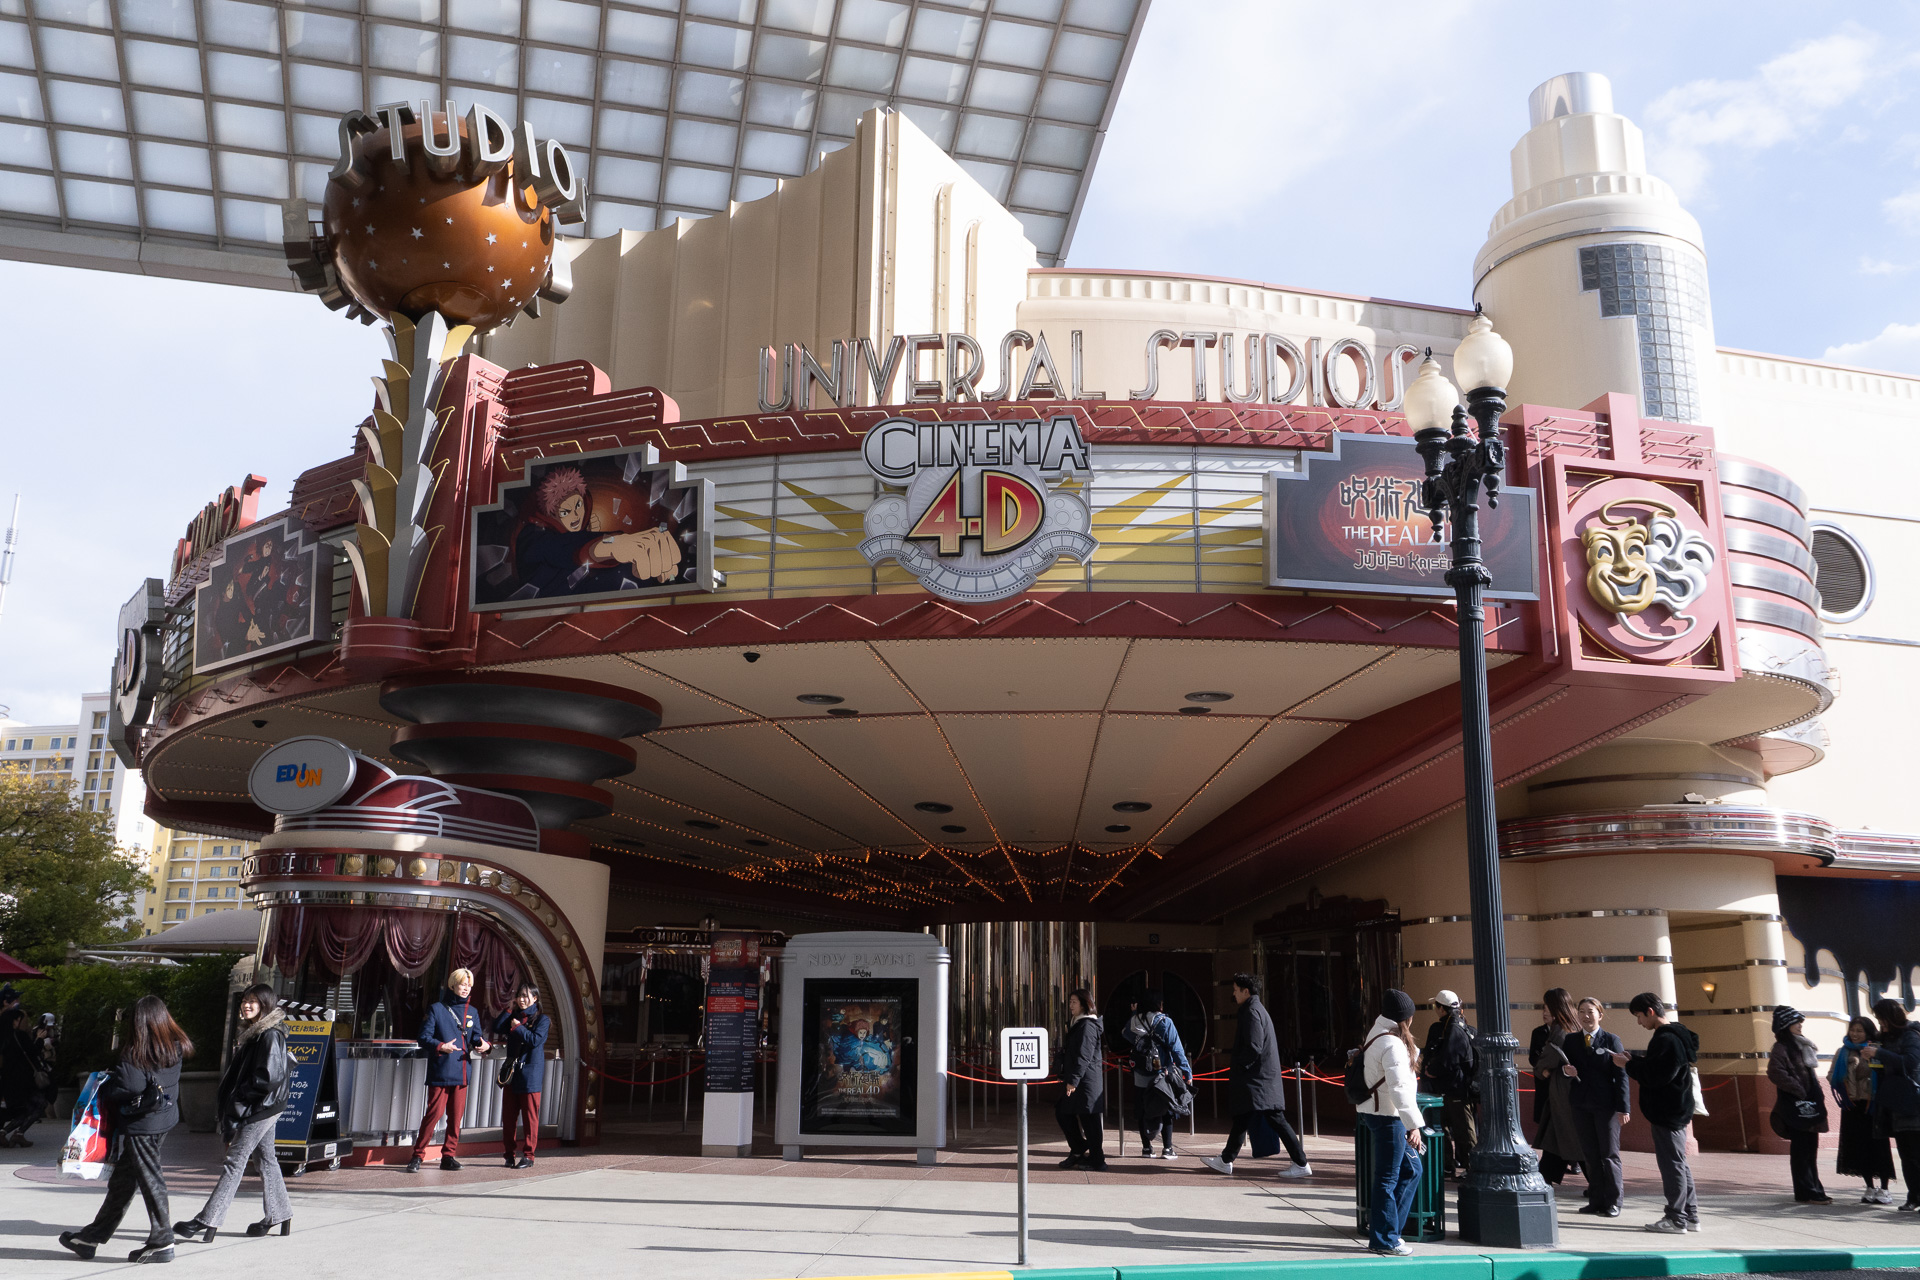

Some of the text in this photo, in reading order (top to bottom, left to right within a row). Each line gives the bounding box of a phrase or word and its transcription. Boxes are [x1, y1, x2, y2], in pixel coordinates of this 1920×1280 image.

[758, 329, 1421, 414] UNIVERSAL STUDIOS
[864, 416, 1091, 480] CINEMA
[1341, 525, 1370, 540] THE
[1369, 524, 1426, 548] REAL
[275, 762, 323, 788] EDION
[808, 952, 916, 967] NOW PLAYING
[850, 968, 872, 978] EDION
[1016, 1042, 1033, 1051] TAXI
[1014, 1054, 1035, 1063] ZONE
